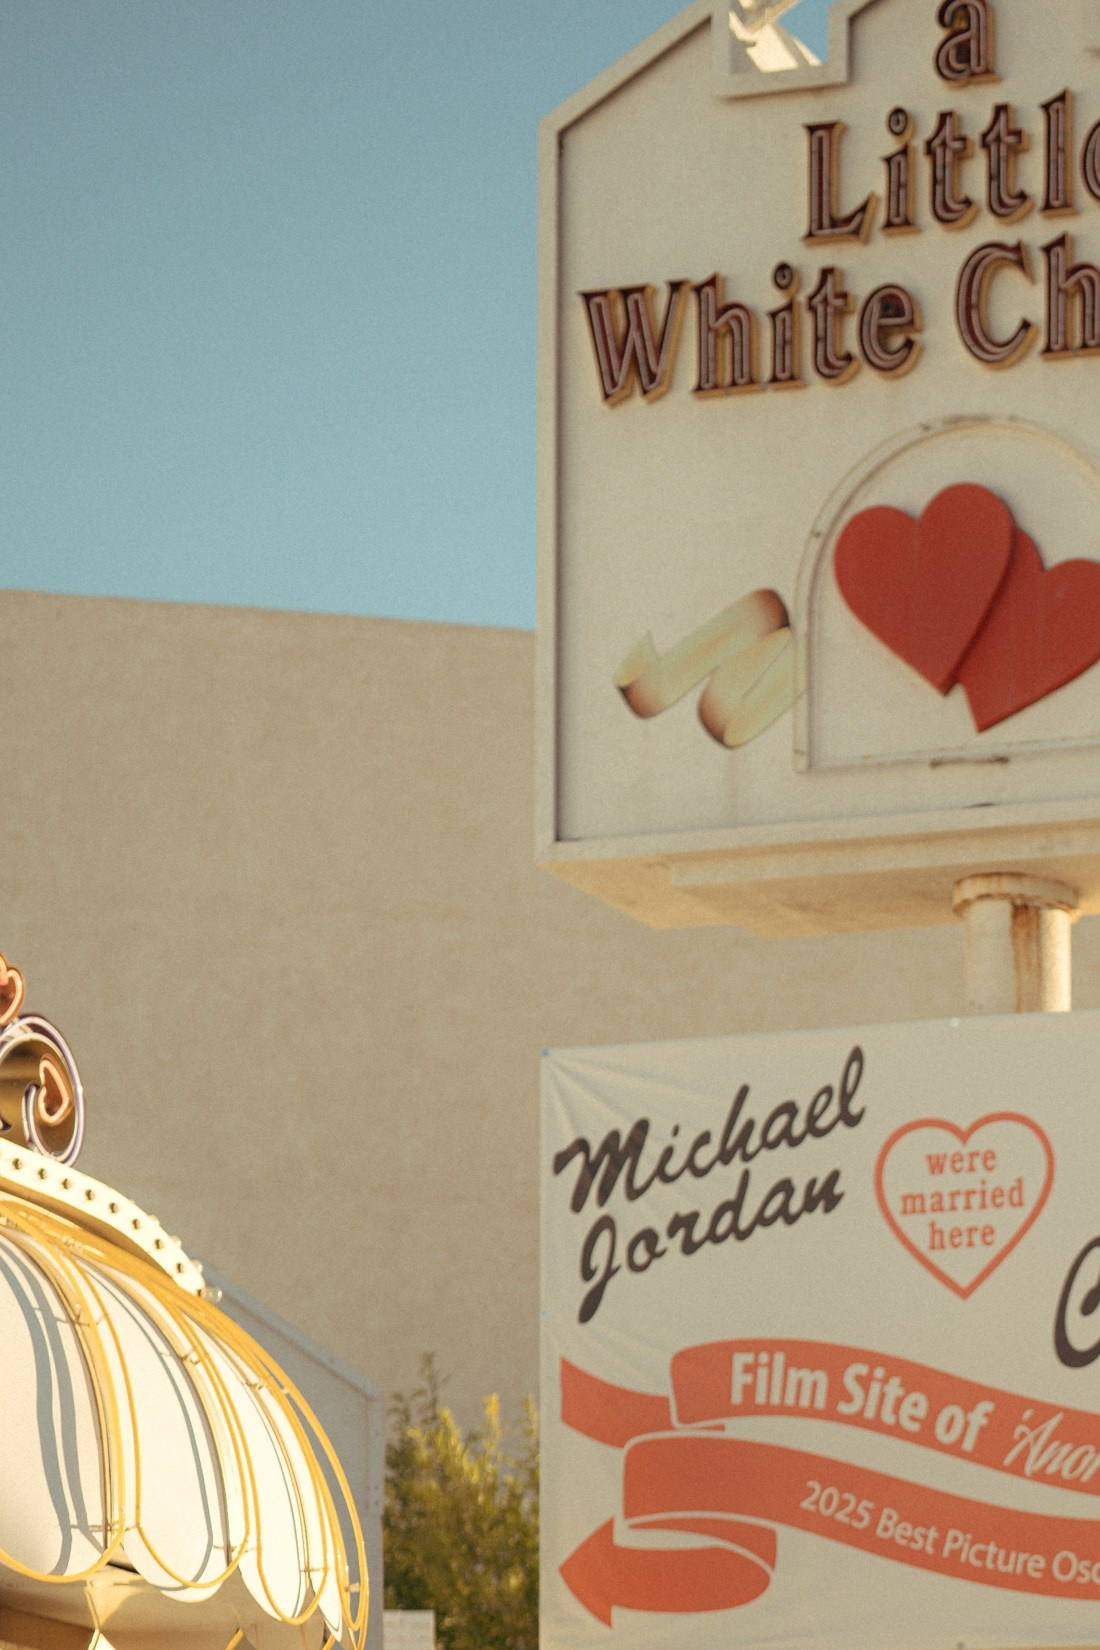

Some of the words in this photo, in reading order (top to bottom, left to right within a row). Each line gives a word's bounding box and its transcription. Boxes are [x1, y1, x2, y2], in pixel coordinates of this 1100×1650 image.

[933, 0, 1002, 87] a
[580, 260, 924, 406] White
[553, 1044, 868, 1213] Michael
[926, 1144, 999, 1176] were
[578, 1168, 845, 1325] Jordan
[900, 1178, 1025, 1218] married
[927, 1218, 998, 1253] here
[730, 1351, 829, 1411] Film
[836, 1361, 926, 1433] Site
[935, 1401, 996, 1452] of
[800, 1480, 875, 1531] 2025
[876, 1511, 937, 1557] Best
[942, 1531, 1046, 1580] Picture
